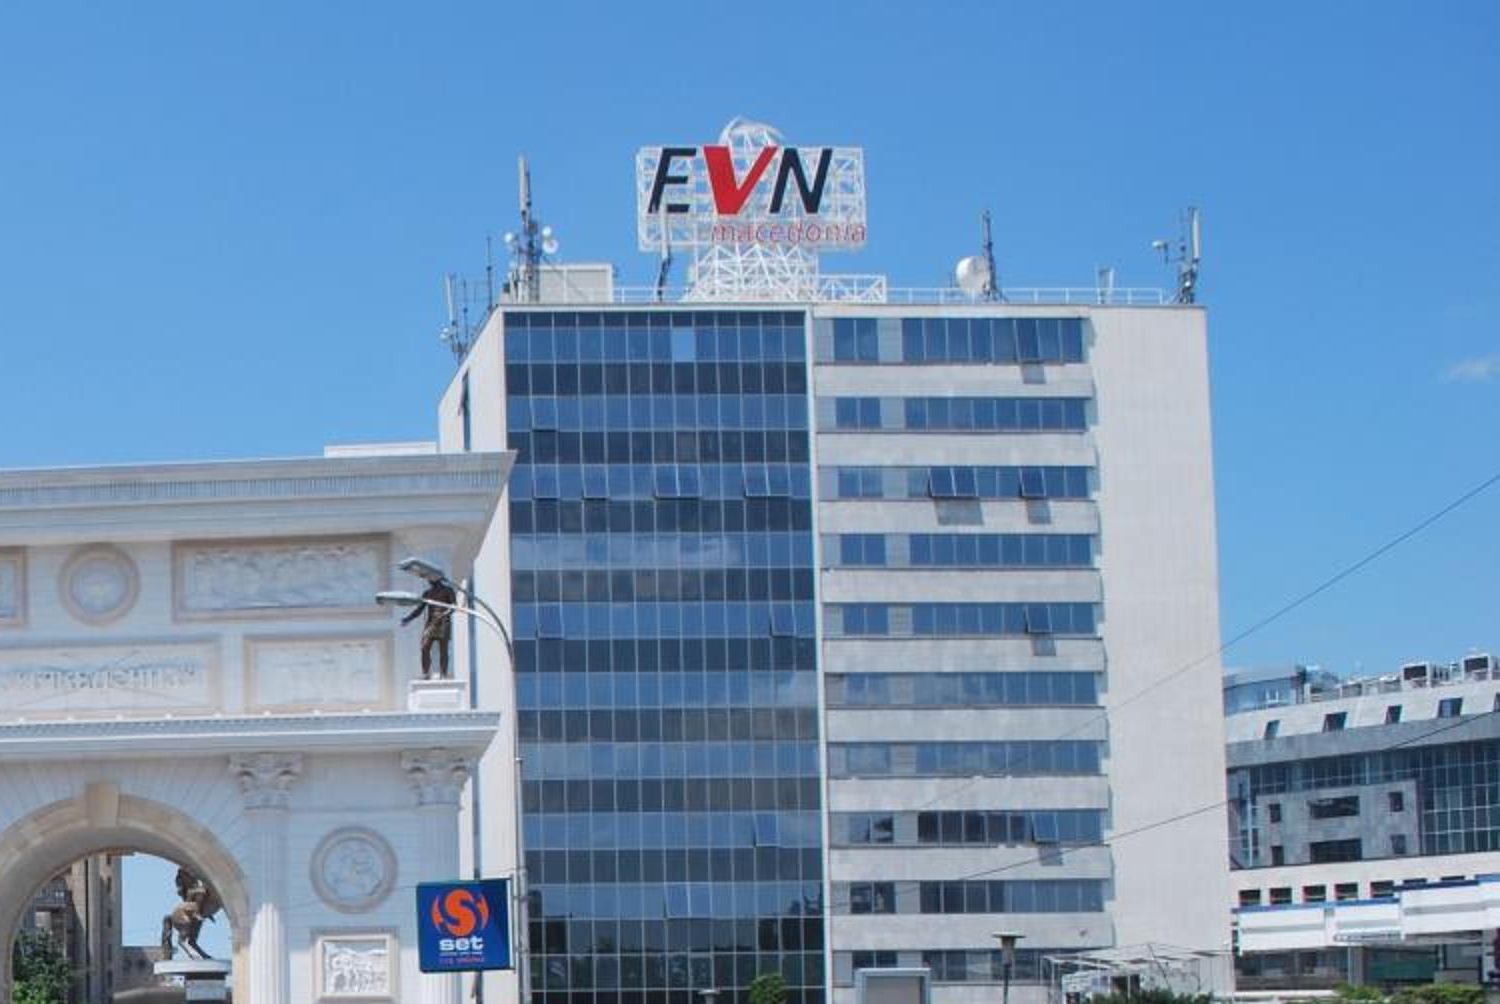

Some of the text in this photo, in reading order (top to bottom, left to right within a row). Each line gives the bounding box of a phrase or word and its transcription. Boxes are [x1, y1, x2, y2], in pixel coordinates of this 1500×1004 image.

[648, 145, 833, 215] EVN
[711, 222, 867, 243] macedonia
[439, 936, 484, 951] set
